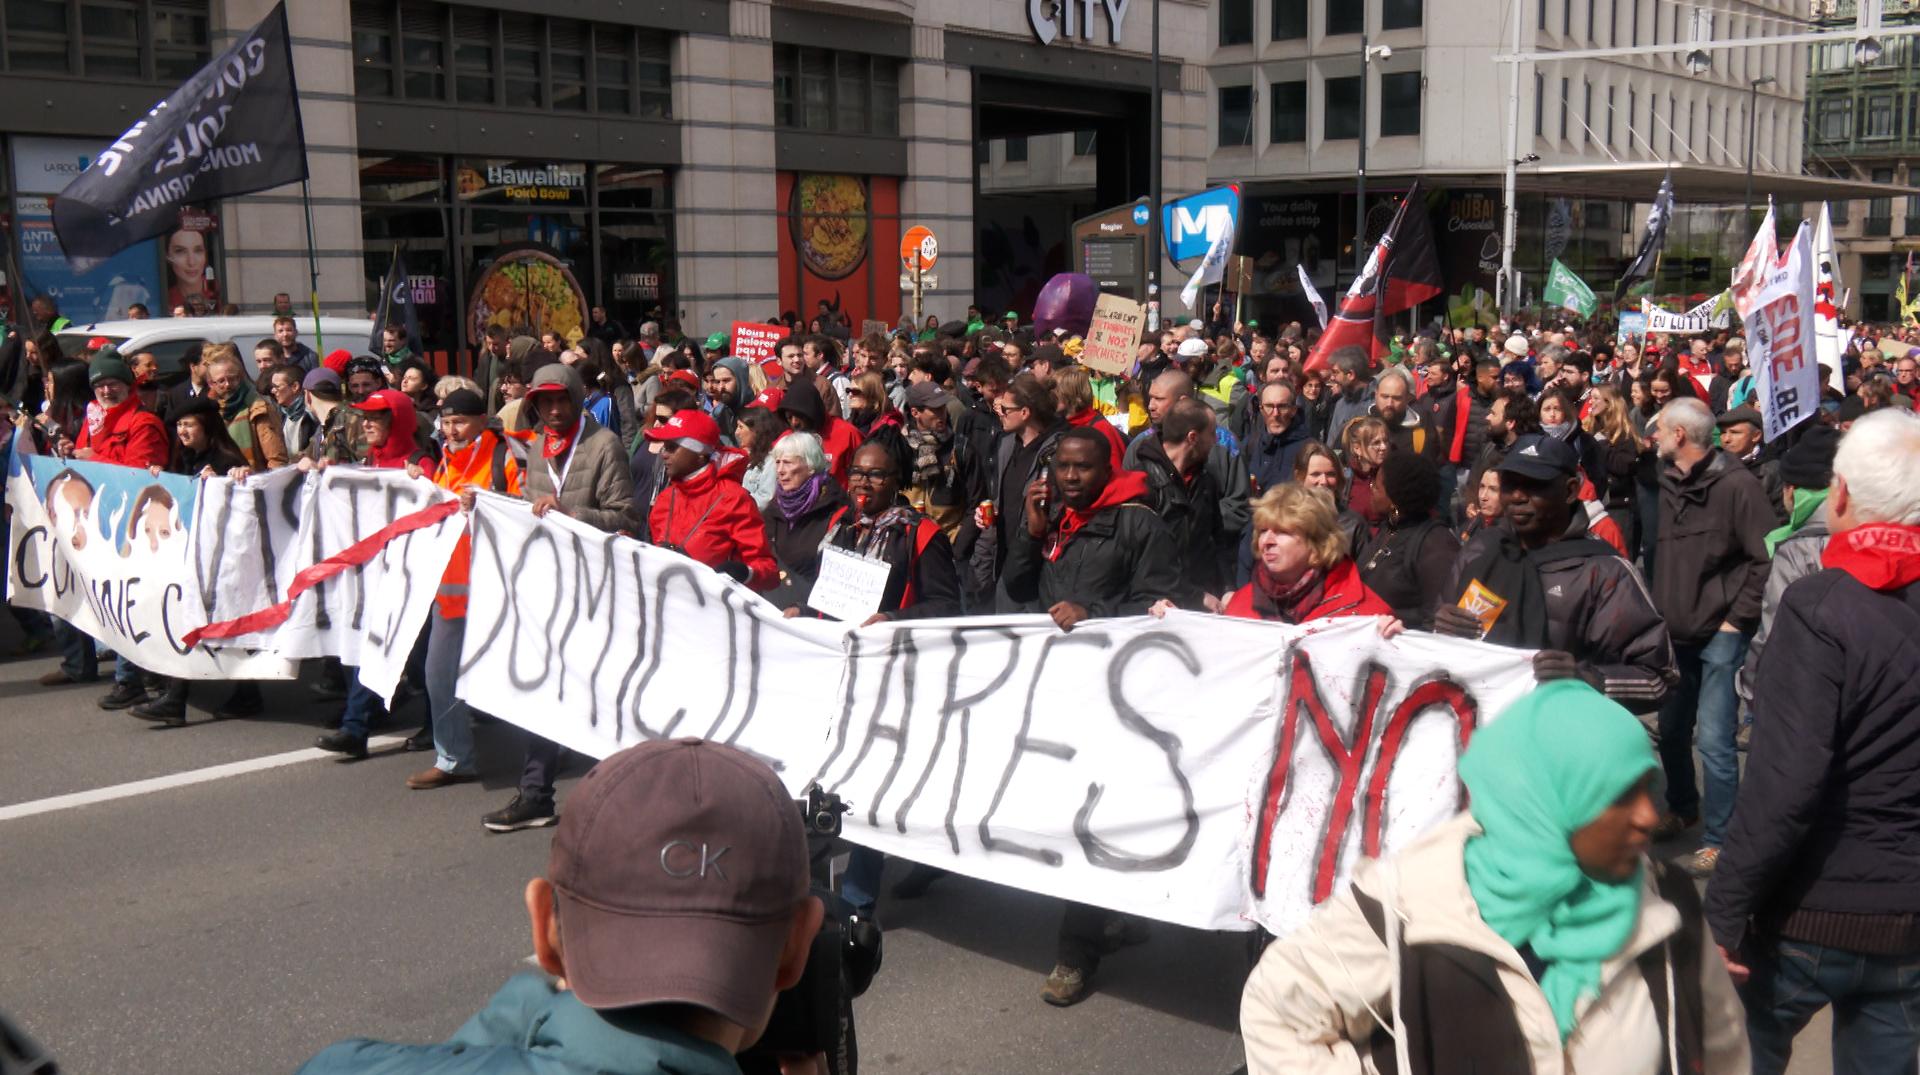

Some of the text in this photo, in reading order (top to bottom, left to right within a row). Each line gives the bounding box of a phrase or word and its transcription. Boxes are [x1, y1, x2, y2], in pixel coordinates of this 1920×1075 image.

[487, 166, 585, 187] Hawaiian
[505, 187, 570, 200] Poké Bowl
[1263, 199, 1319, 214] Your daily
[1451, 199, 1494, 219] DUBAI
[1259, 215, 1321, 228] coffee stop
[23, 243, 41, 252] UV
[613, 273, 659, 287] LIMITED
[613, 287, 659, 299] EDITION
[737, 328, 765, 338] Nous
[660, 840, 733, 882] CK
